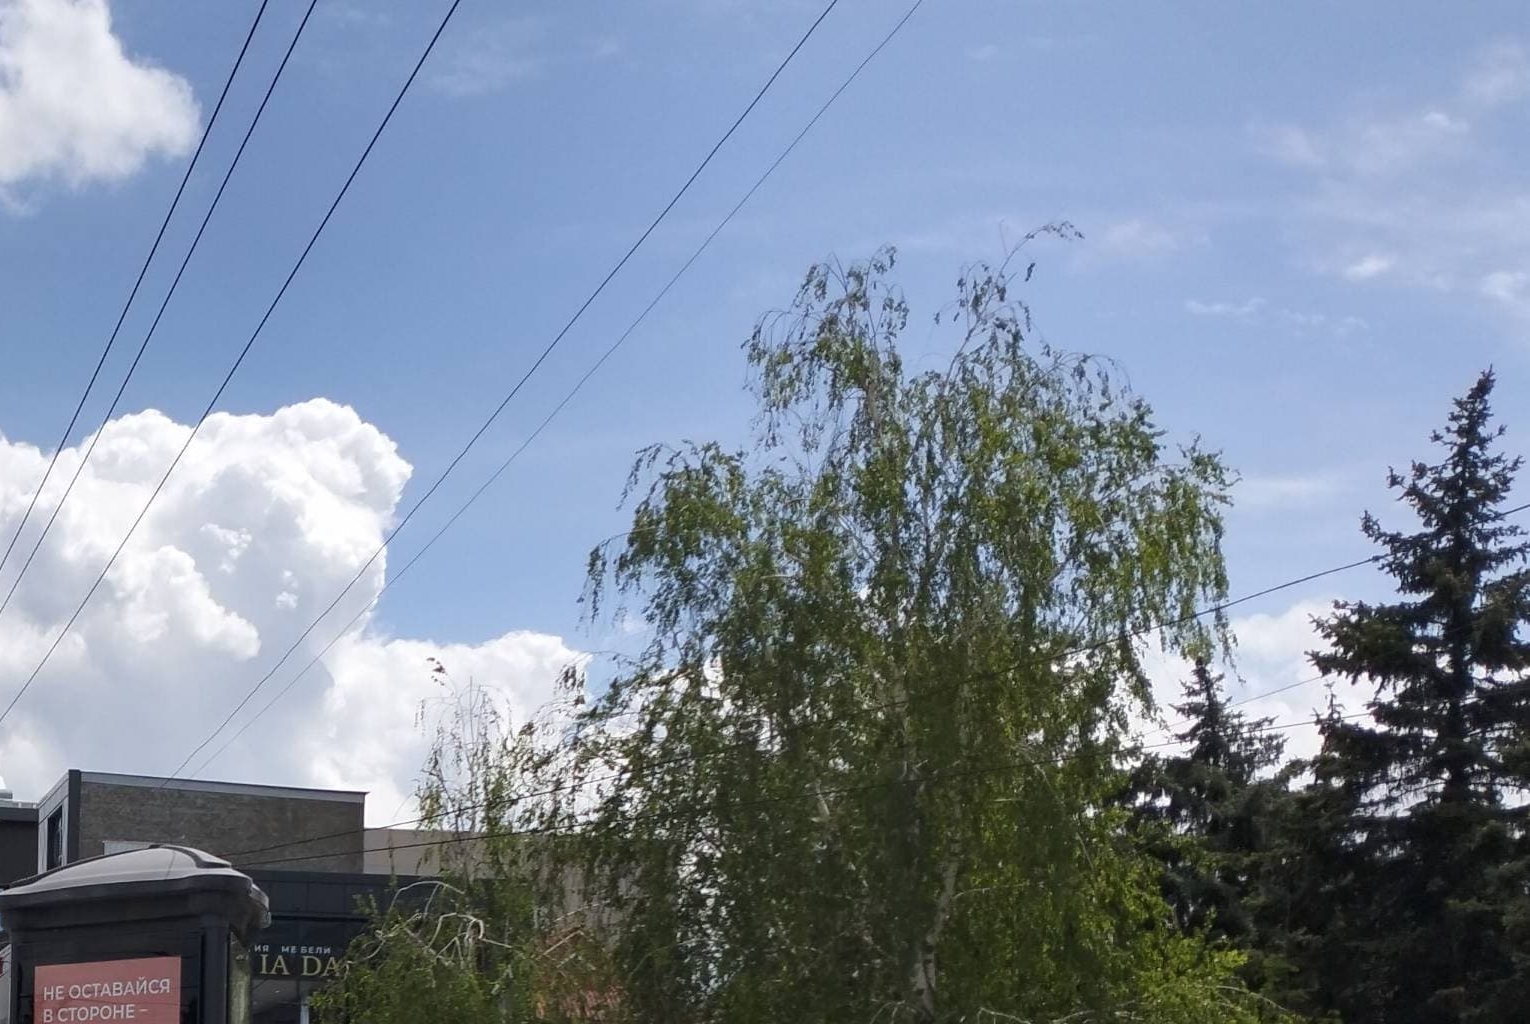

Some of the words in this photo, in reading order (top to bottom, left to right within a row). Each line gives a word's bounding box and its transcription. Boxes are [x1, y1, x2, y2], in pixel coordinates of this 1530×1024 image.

[43, 985, 65, 1001] НЕ
[69, 976, 171, 999] ОСТАВАЙСЯ
[43, 1008, 53, 1024] В
[57, 1004, 136, 1022] СТОРОНЕ
